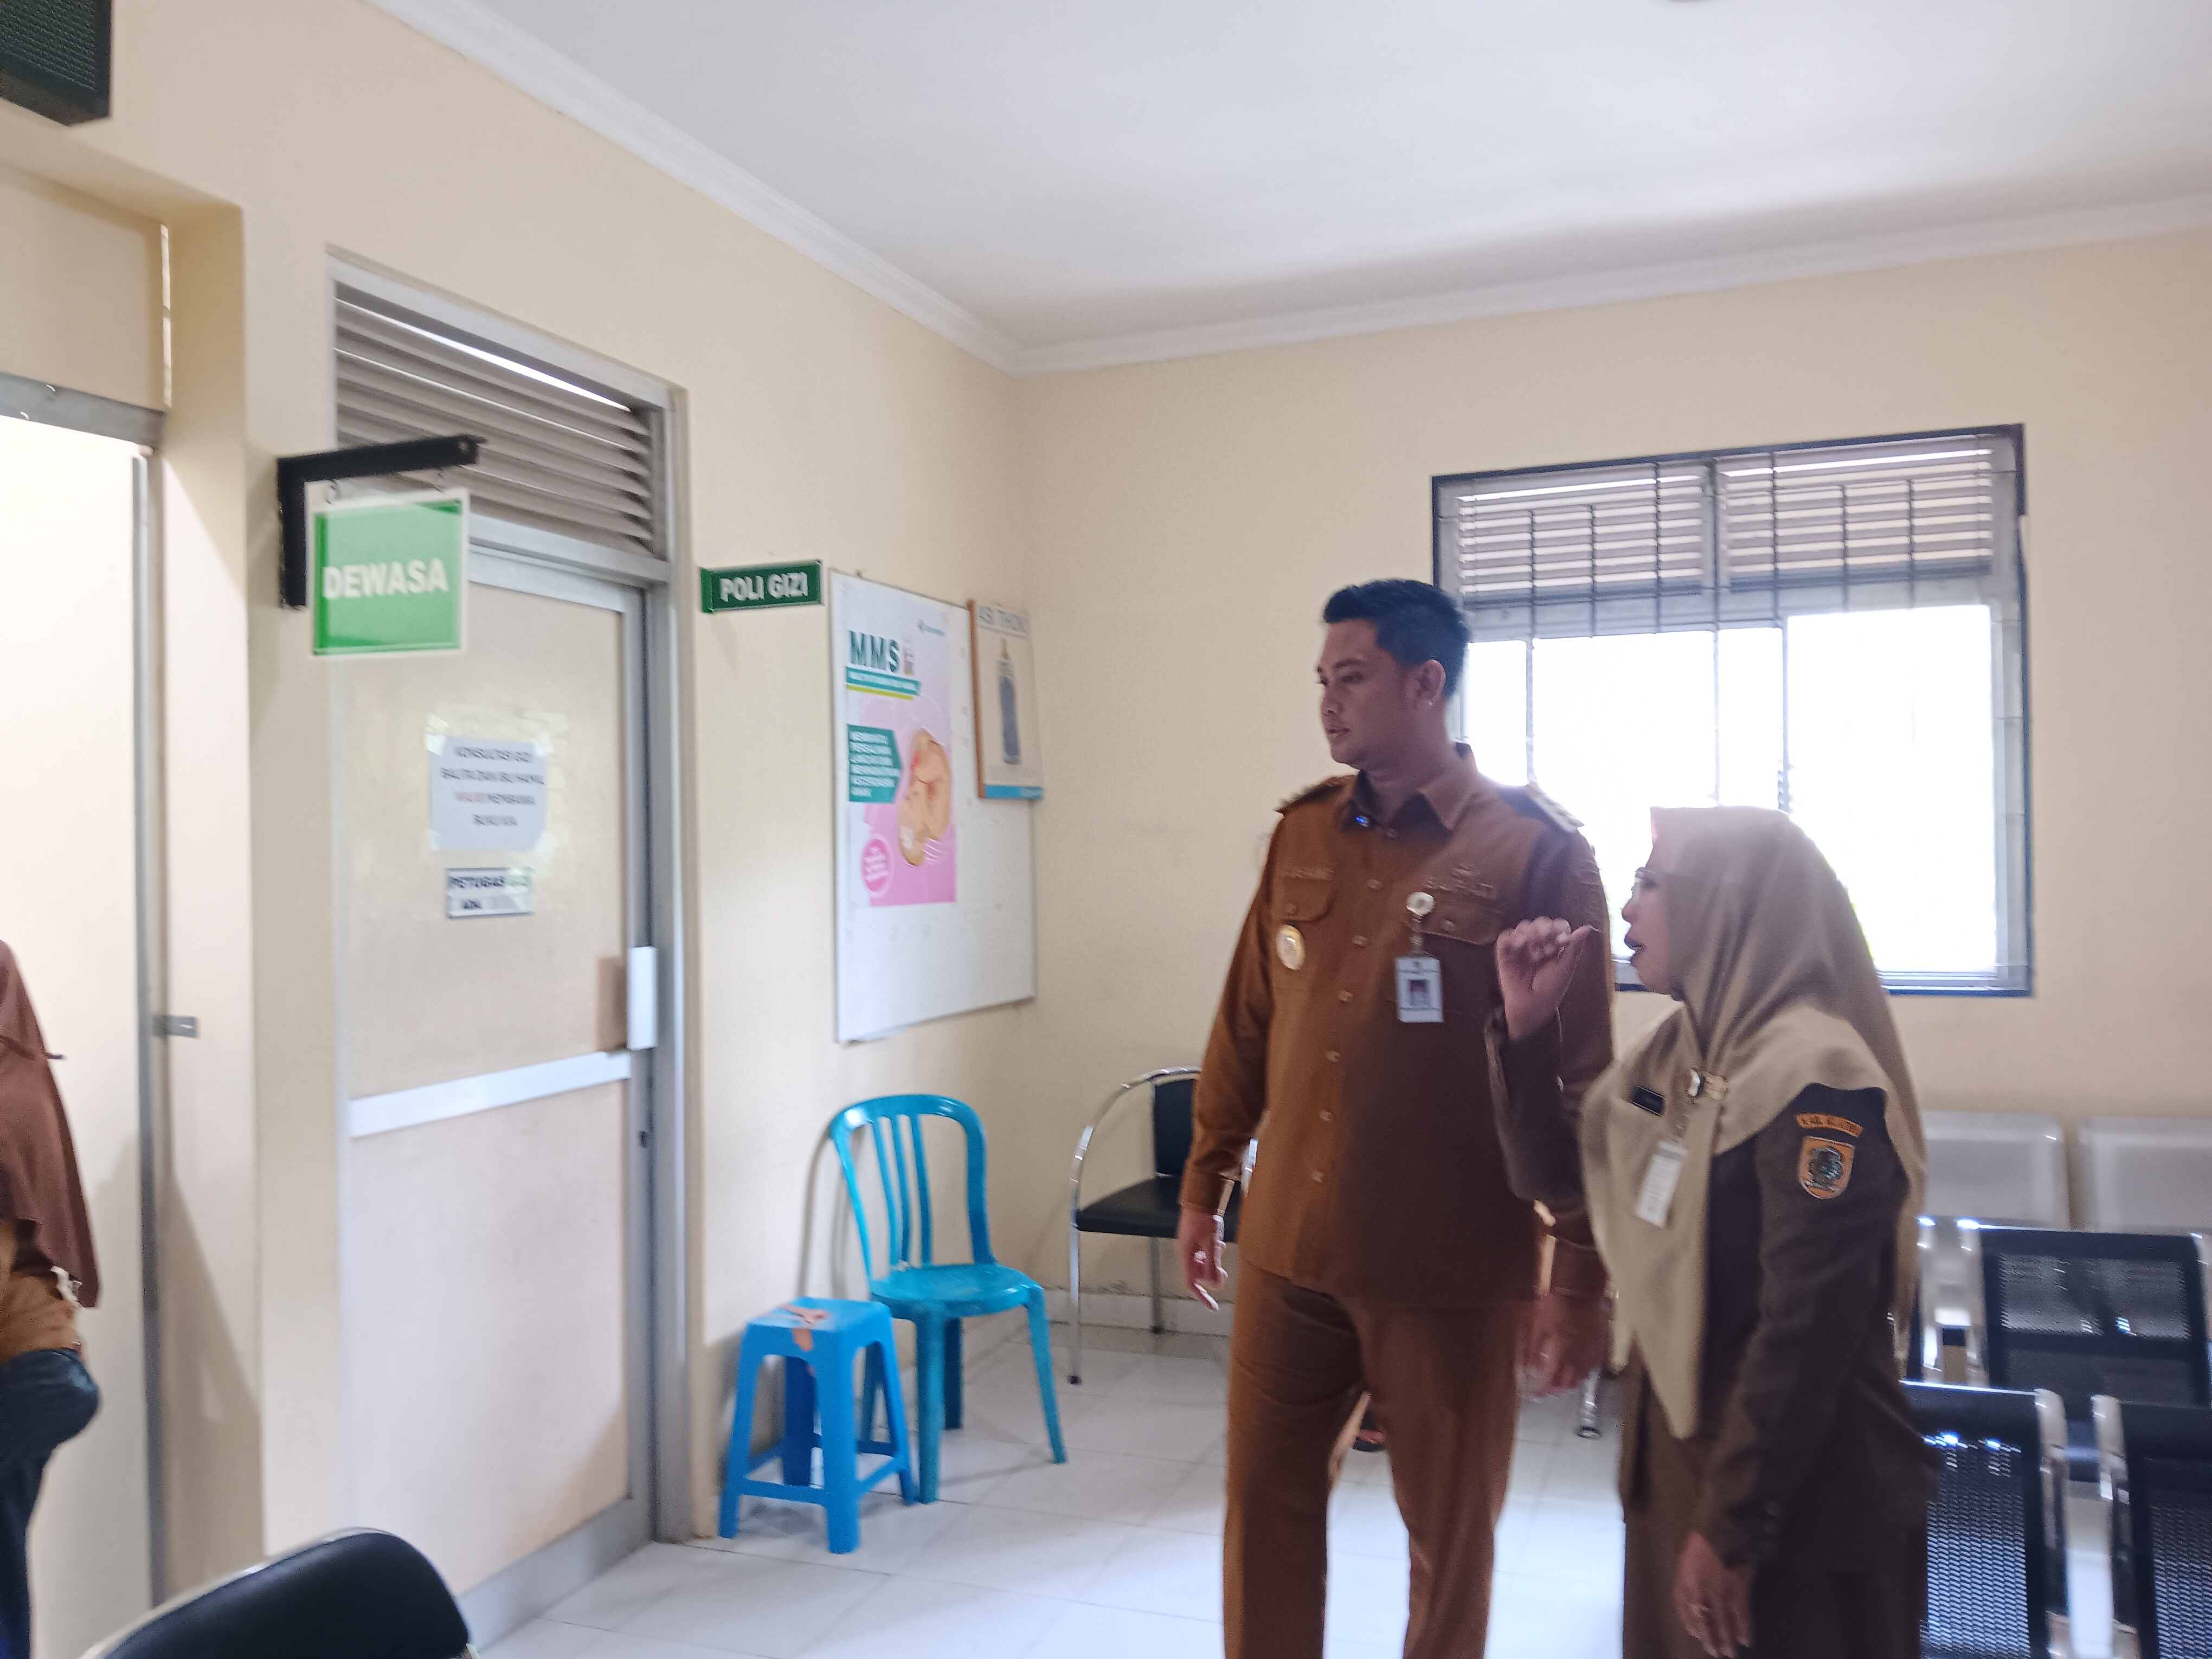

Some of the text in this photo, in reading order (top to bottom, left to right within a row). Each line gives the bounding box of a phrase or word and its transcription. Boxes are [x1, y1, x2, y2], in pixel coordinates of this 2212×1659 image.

[323, 558, 449, 600] DEWASA
[719, 572, 808, 602] POLI GIZI
[848, 631, 899, 673] MMS
